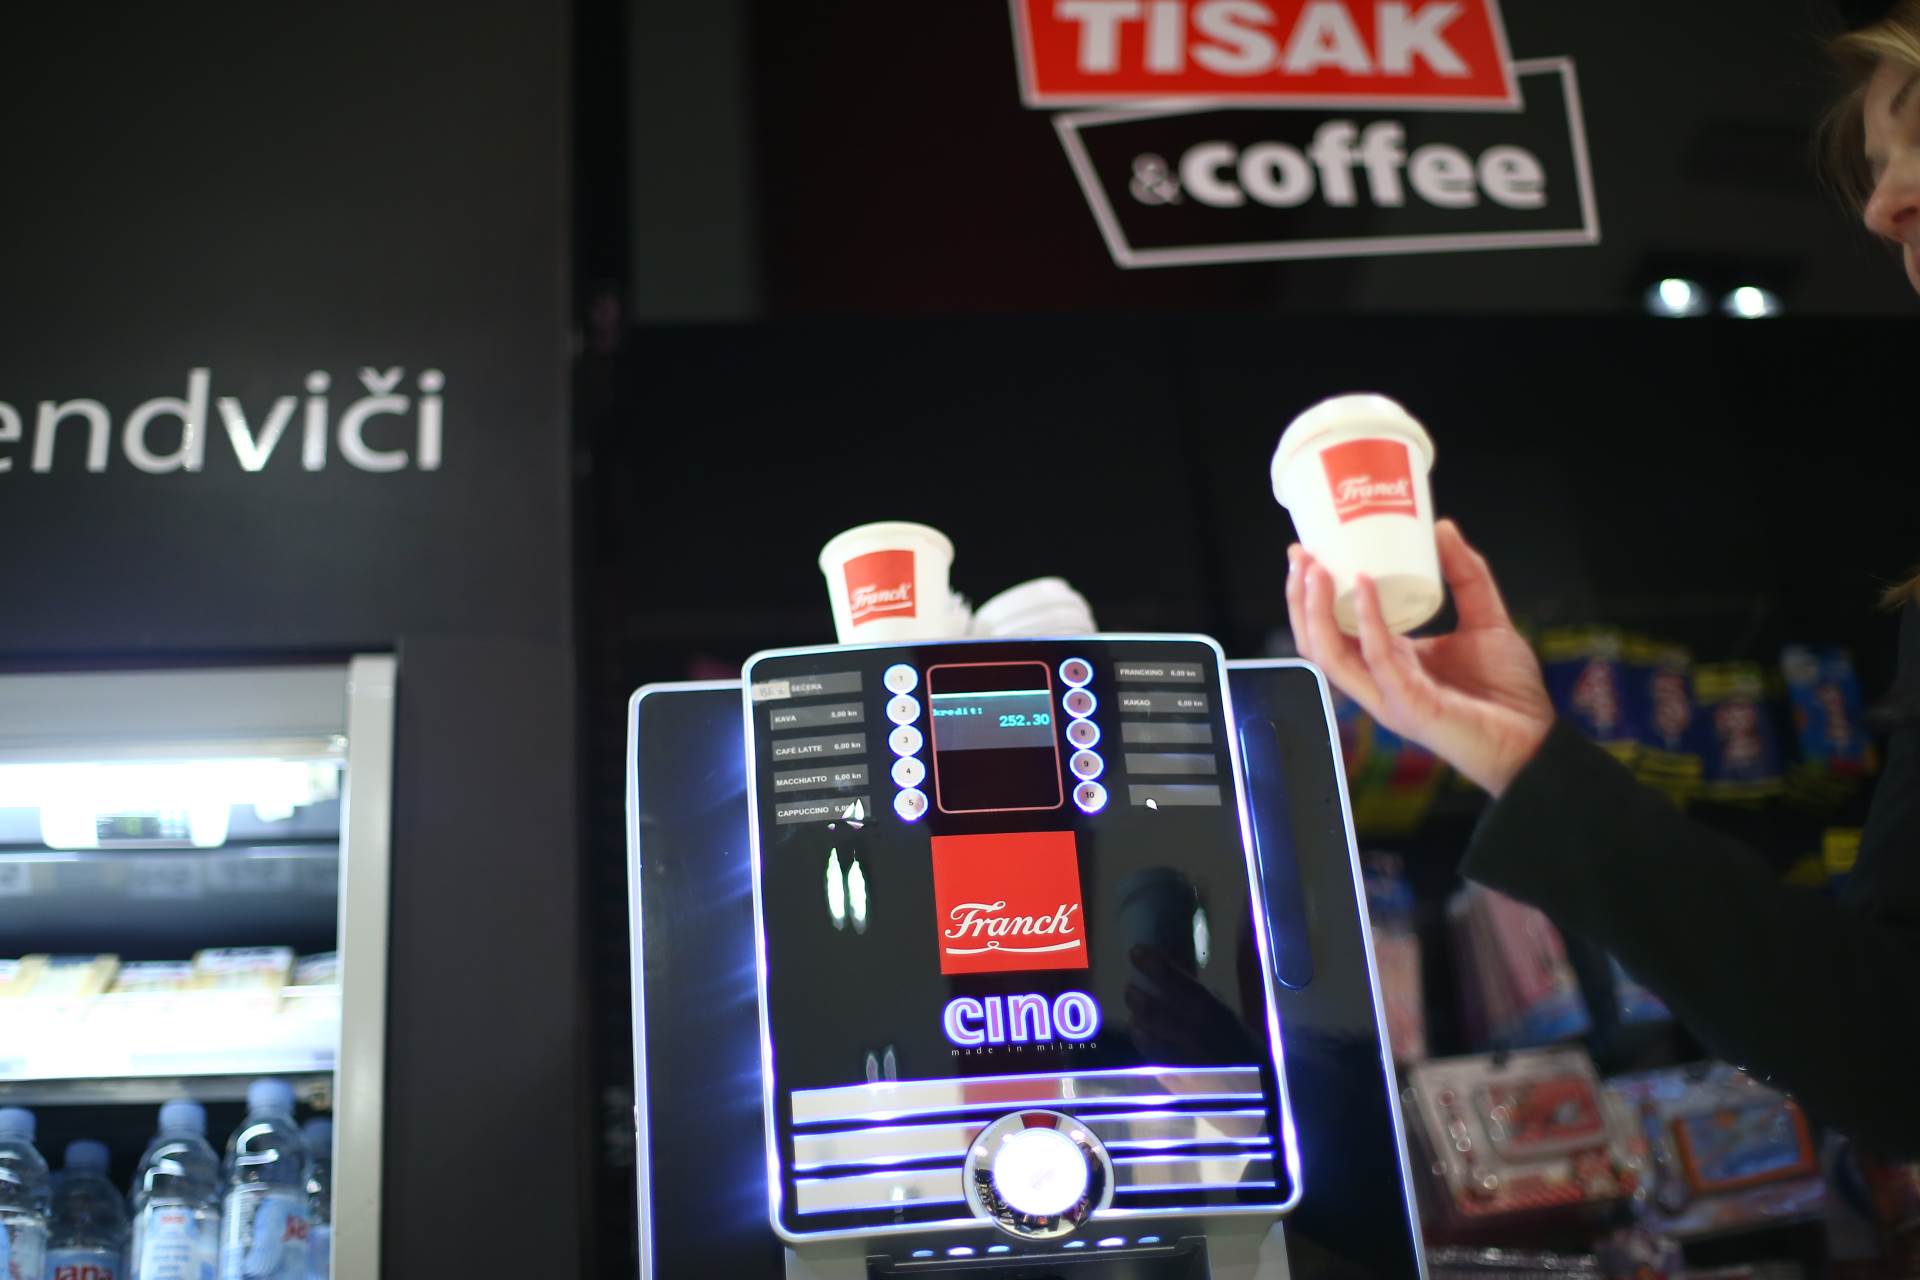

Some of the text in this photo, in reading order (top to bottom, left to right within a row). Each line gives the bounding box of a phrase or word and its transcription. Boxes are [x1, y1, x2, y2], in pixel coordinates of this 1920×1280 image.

[1053, 0, 1472, 77] TISAK
[1123, 699, 1151, 707] KAKAO
[1194, 699, 1204, 707] kn
[775, 715, 797, 723] KAVA
[848, 709, 858, 718] kn
[932, 706, 983, 717] kredit:
[999, 713, 1050, 728] 252.30
[798, 744, 823, 754] LATTE
[851, 741, 861, 750] kn
[776, 775, 828, 787] MACCHIATTO
[852, 772, 862, 780] kn
[777, 805, 829, 818] CAPPUCCINO
[945, 901, 1078, 938] Franck
[951, 1041, 1098, 1057] made in milano
